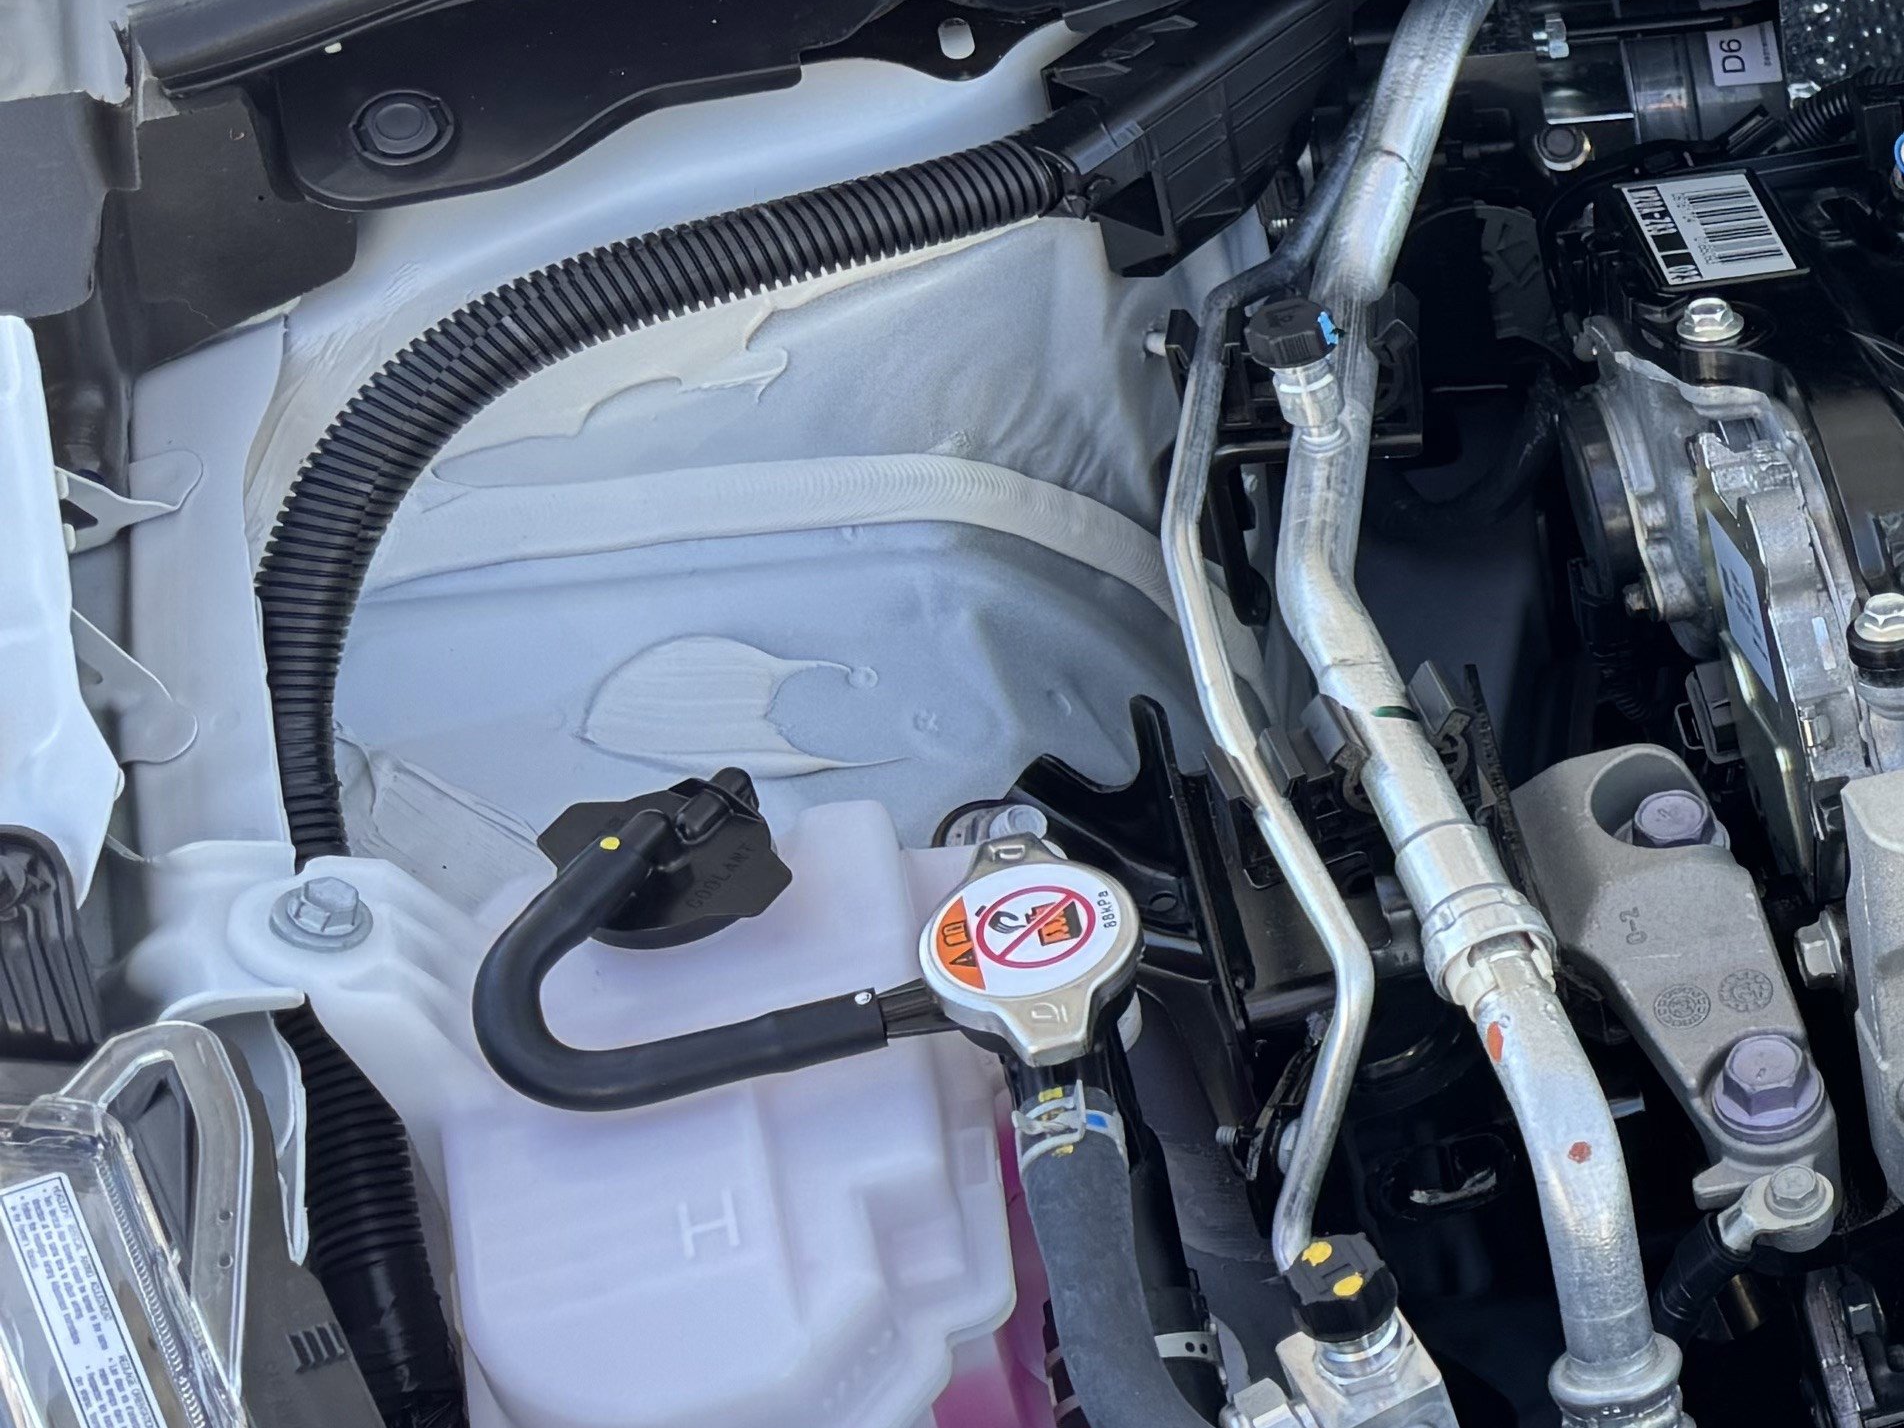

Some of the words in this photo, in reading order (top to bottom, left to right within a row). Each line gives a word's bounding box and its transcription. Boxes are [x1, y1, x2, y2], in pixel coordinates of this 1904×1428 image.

[1721, 36, 1743, 75] D6
[686, 839, 758, 912] COOLANT
[678, 1190, 741, 1260] H
